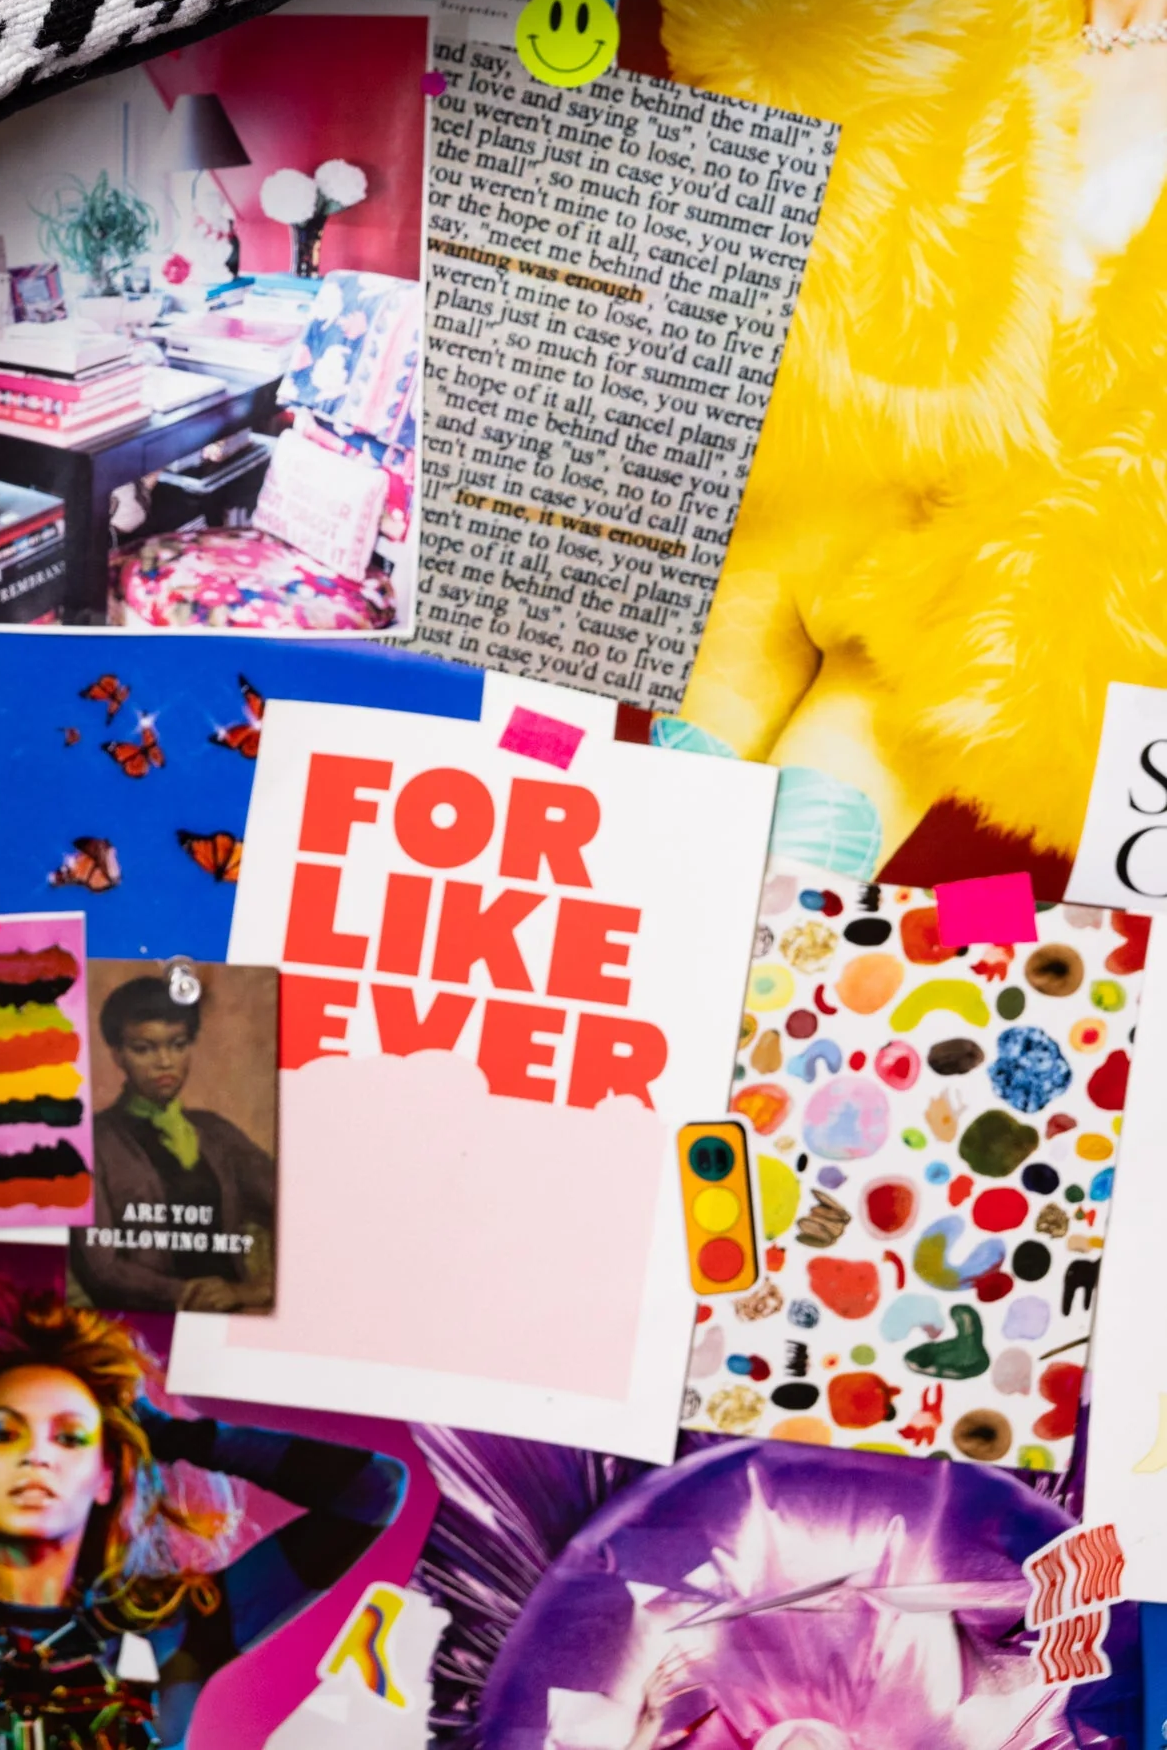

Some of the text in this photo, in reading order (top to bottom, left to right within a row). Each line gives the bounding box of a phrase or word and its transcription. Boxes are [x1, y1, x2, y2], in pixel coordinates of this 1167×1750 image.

[432, 44, 466, 63] nd
[588, 84, 624, 103] me
[709, 110, 744, 133] the
[432, 94, 466, 113] ou
[618, 137, 640, 156] to
[703, 161, 731, 179] no
[736, 167, 759, 186] to
[520, 91, 563, 112] and
[773, 155, 817, 176] you
[427, 166, 462, 186] ou
[614, 210, 637, 229] to
[698, 234, 741, 255] you
[434, 139, 470, 163] the
[548, 172, 574, 189] so
[647, 191, 679, 215] for
[588, 151, 610, 173] in
[779, 205, 821, 225] and
[426, 191, 452, 208] or
[456, 194, 491, 217] the
[555, 221, 585, 241] of
[586, 224, 602, 245] it
[515, 261, 559, 282] was
[731, 315, 775, 336] you
[547, 245, 581, 264] me
[667, 271, 702, 294] the
[505, 333, 531, 350] so
[604, 351, 637, 376] for
[546, 312, 567, 334] in
[736, 366, 778, 386] and
[575, 298, 598, 317] to
[660, 322, 689, 340] no
[694, 328, 716, 347] to
[571, 370, 594, 389] to
[654, 394, 697, 415] you
[454, 484, 488, 509] for
[538, 505, 555, 526] it
[558, 516, 603, 538] was
[298, 752, 601, 889] FOR
[283, 862, 642, 1007] LIKE
[279, 973, 668, 1112] EVER
[86, 1227, 254, 1254] FOLLOWING ME?
[122, 1202, 213, 1225] ARE YOU
